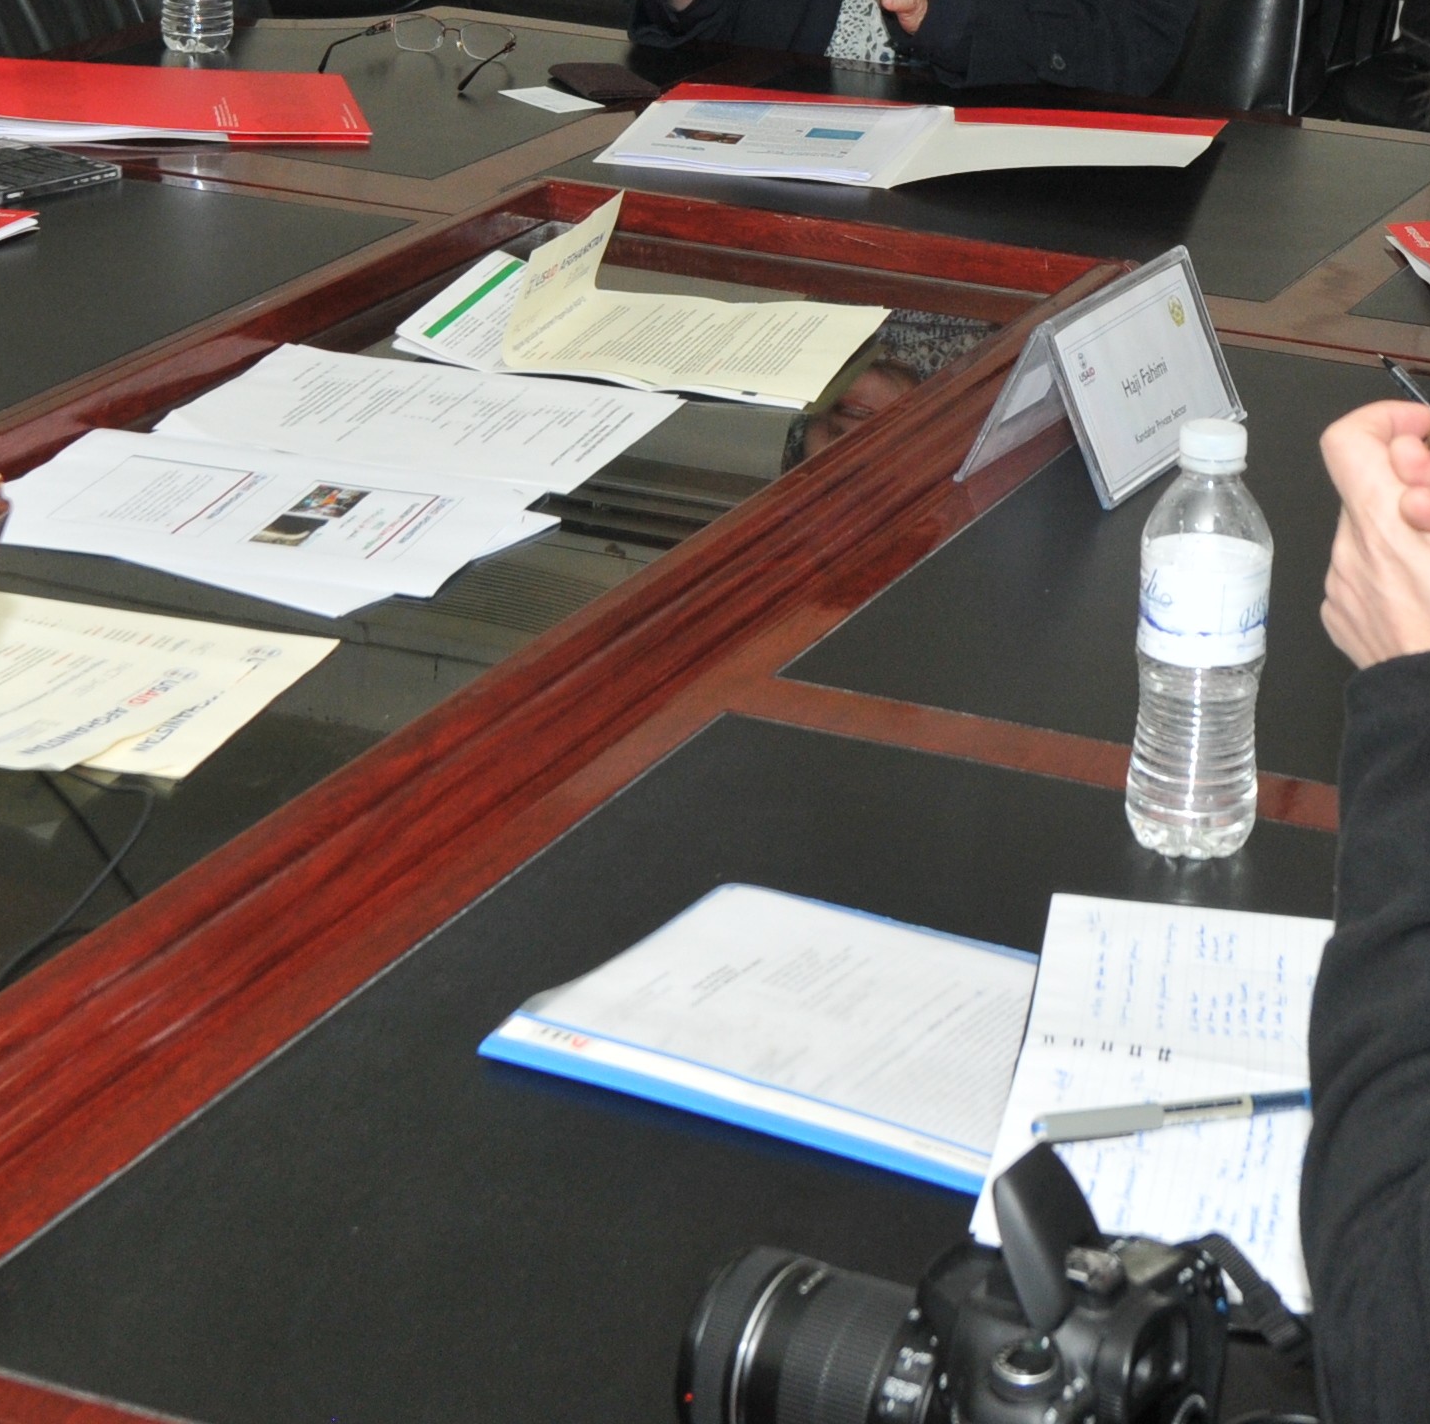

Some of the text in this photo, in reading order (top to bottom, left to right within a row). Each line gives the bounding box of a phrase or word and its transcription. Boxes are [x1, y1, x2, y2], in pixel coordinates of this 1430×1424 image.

[1078, 366, 1096, 384] USAID
[1121, 374, 1142, 398] Haji
[128, 677, 180, 708] USAID
[20, 706, 129, 756] AFGHANISTAN
